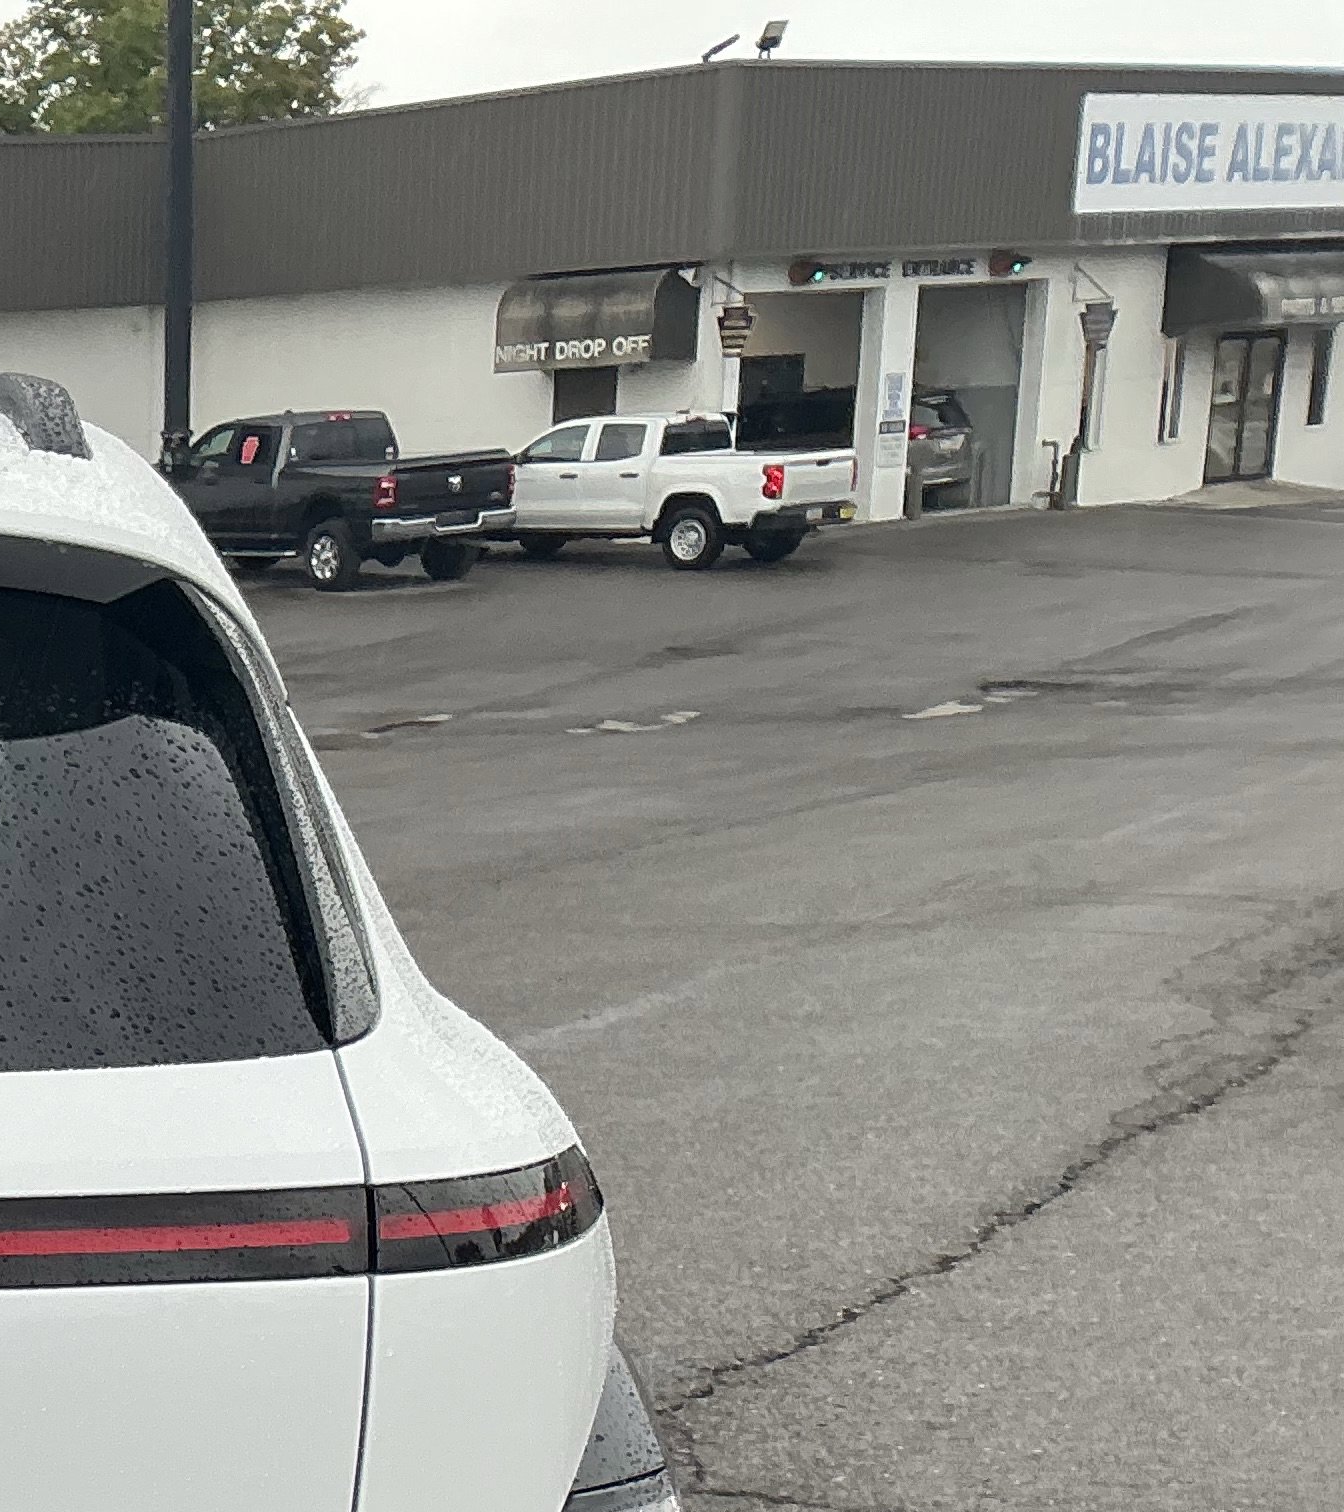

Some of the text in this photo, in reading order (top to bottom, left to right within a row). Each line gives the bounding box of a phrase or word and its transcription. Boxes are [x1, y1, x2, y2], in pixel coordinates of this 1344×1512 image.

[1086, 120, 1344, 184] BLAISE ALEXA
[495, 334, 652, 363] NIGHT DROP OFF
